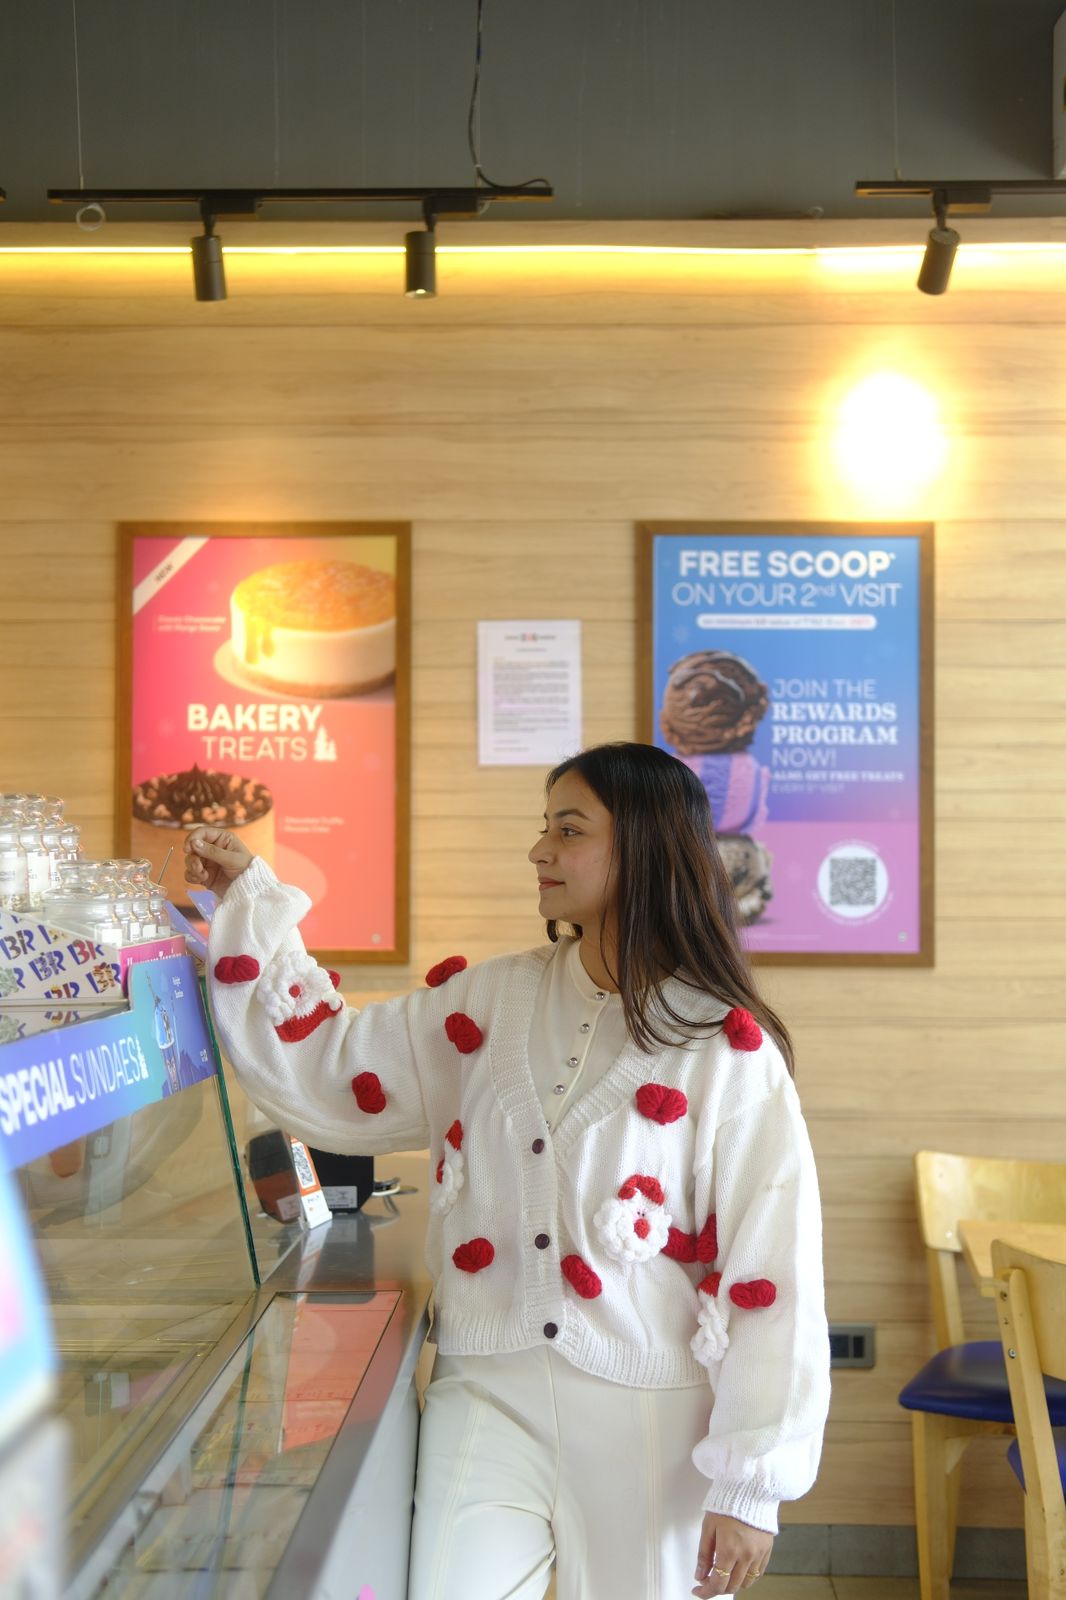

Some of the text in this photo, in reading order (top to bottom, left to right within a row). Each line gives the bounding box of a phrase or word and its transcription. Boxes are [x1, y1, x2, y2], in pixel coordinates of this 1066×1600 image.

[679, 550, 761, 576] FREE
[671, 582, 902, 607] ON YOUR 2nd VISIT
[772, 679, 877, 699] JOIN THE
[187, 704, 323, 732] BAKERY
[772, 703, 897, 722] REWARDS
[772, 725, 898, 744] PROGRAM
[202, 737, 308, 761] TREATS
[772, 748, 837, 767] NOW!
[0, 1036, 141, 1136] SPECIAL SUNDAES
